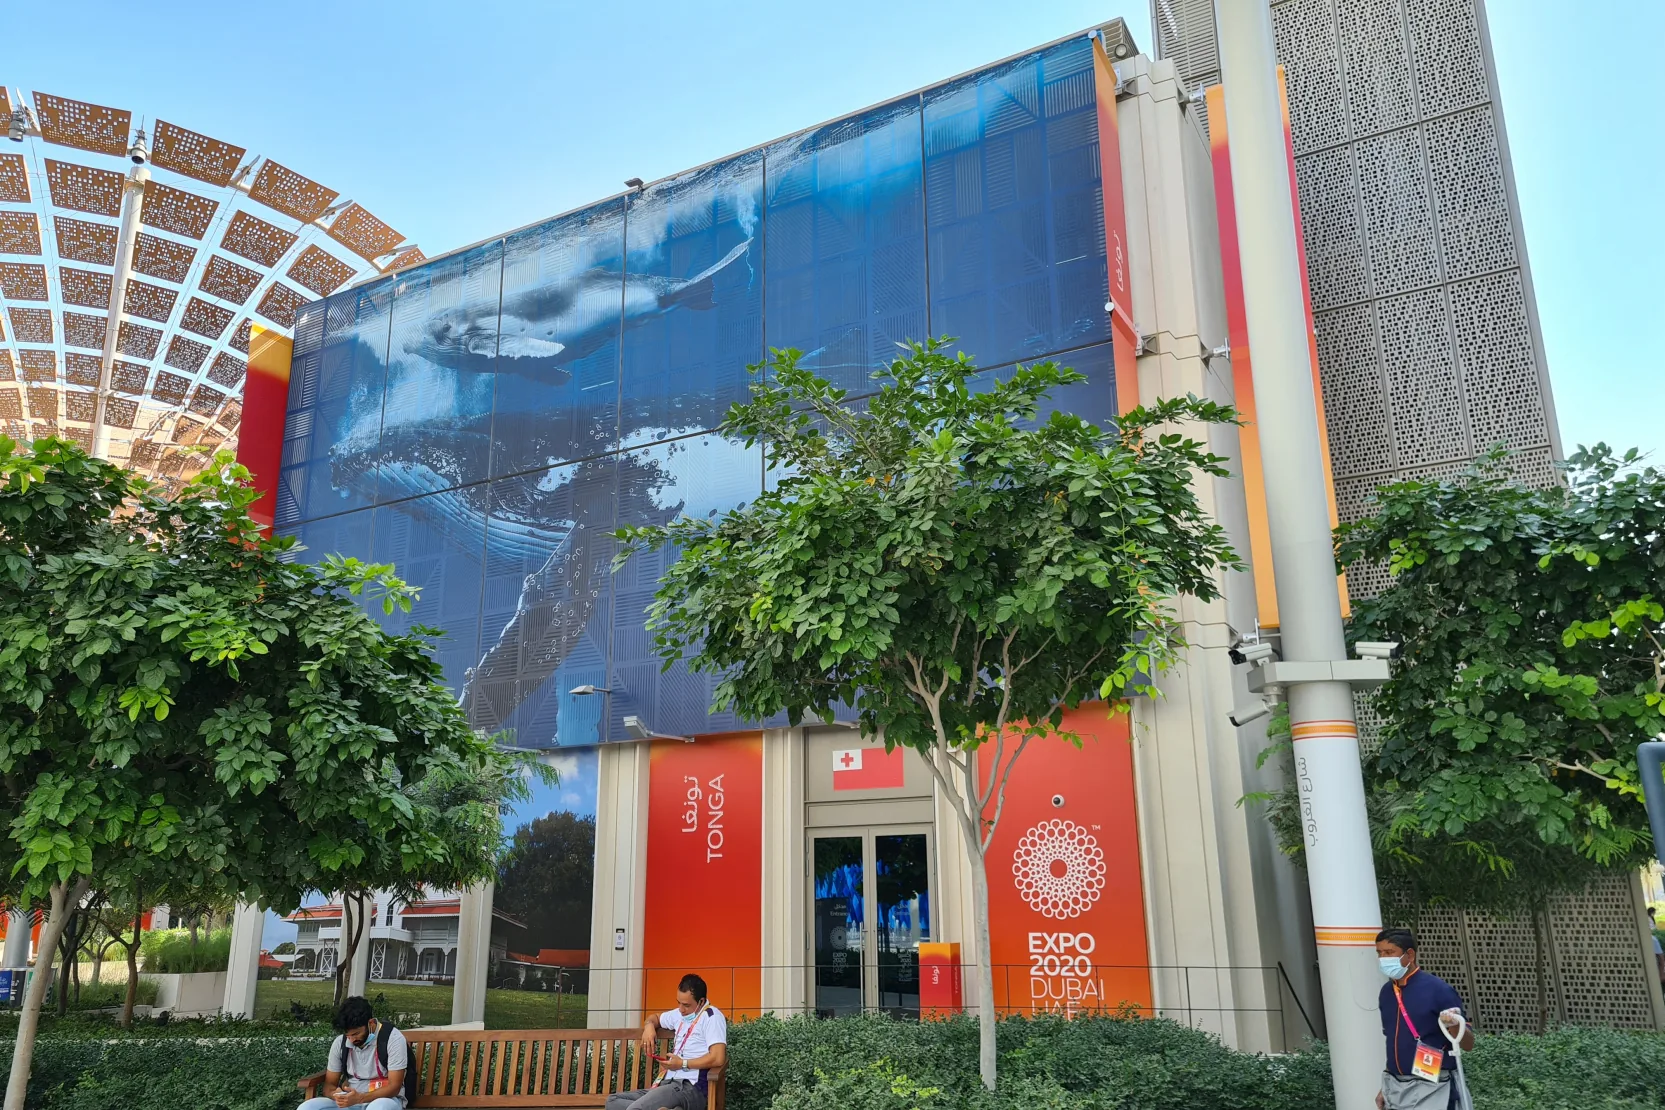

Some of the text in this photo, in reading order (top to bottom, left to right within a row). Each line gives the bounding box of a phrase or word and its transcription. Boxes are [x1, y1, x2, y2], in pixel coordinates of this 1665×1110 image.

[681, 775, 702, 833] تونغا
[707, 773, 724, 863] TONGA
[1298, 757, 1319, 847] شارع الغروب
[1028, 932, 1096, 954] EXPO
[1029, 955, 1092, 977] 2020
[1030, 977, 1105, 1000] DUBAI
